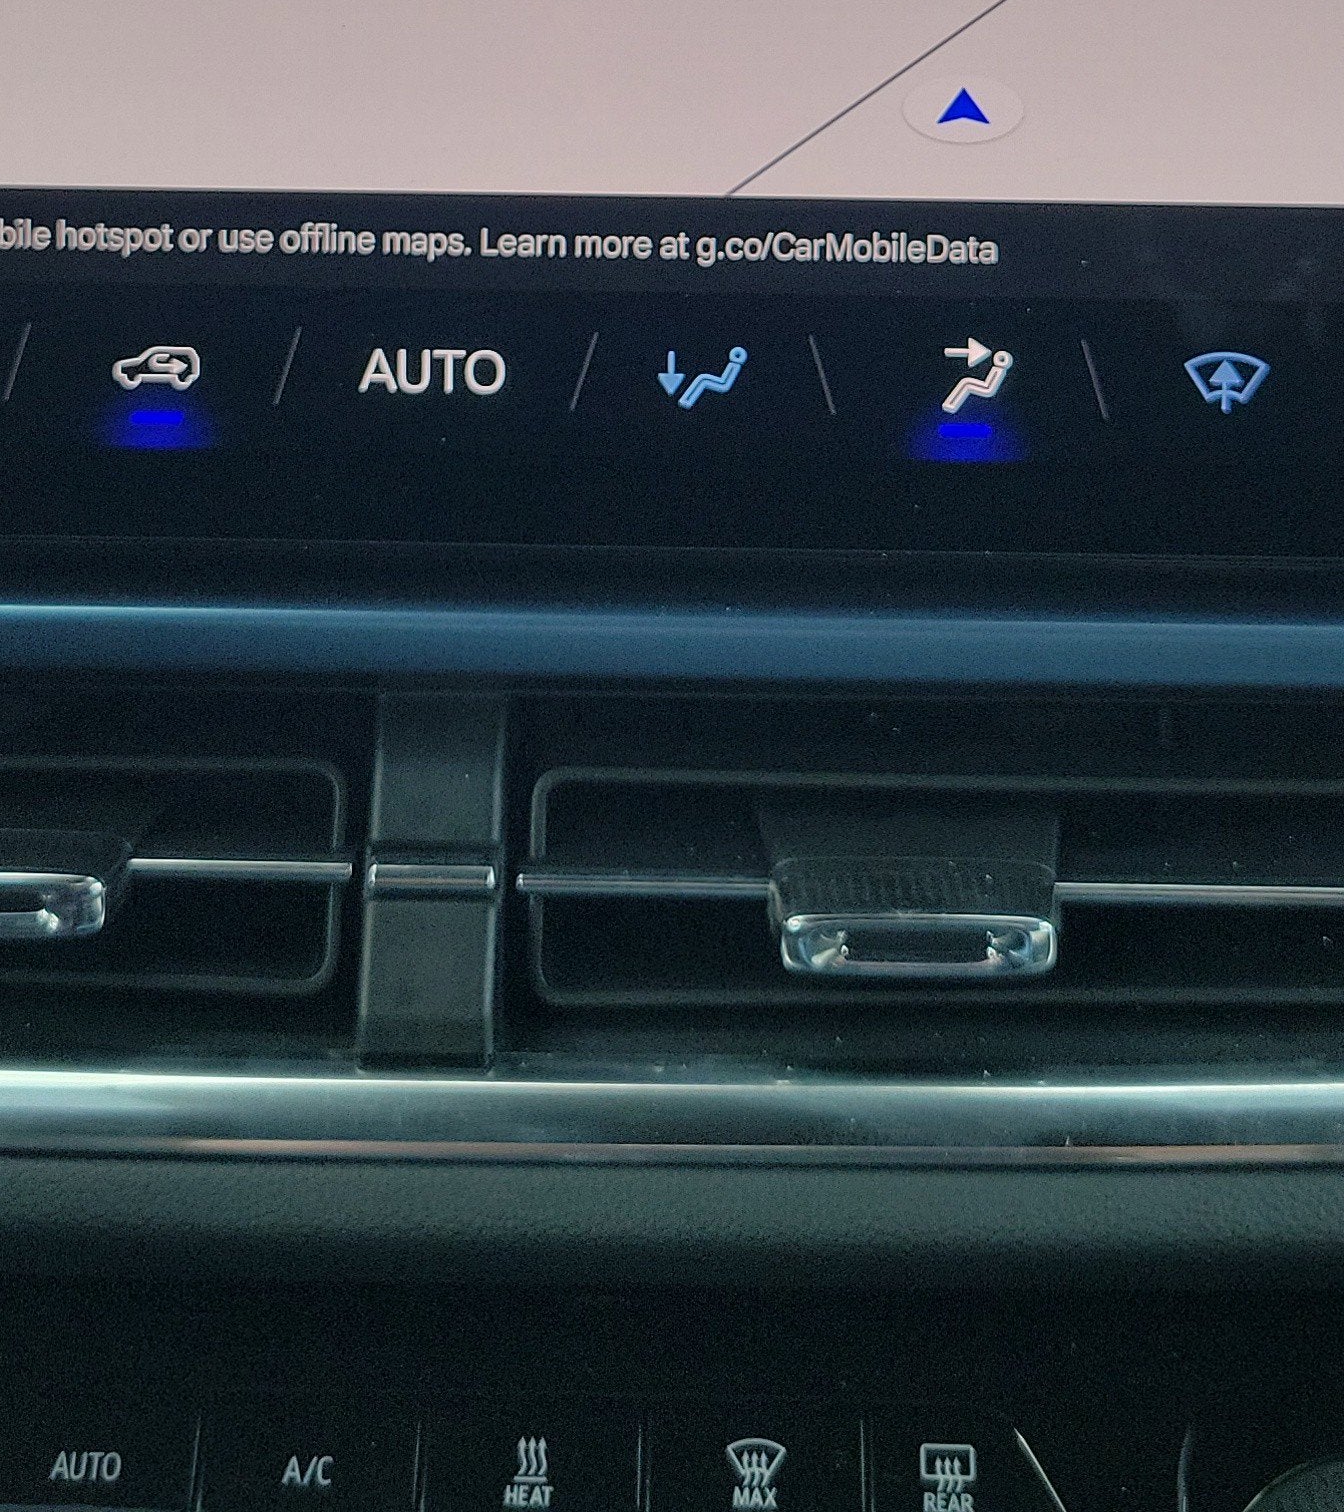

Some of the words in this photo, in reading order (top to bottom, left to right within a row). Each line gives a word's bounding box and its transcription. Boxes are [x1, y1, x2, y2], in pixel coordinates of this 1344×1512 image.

[55, 218, 175, 258] hotspot
[177, 228, 214, 253] or
[217, 229, 274, 254] use
[279, 222, 376, 255] offline
[382, 231, 473, 263] maps.
[479, 227, 567, 258] Learn
[573, 234, 654, 260] more
[659, 232, 690, 261] at
[695, 231, 1000, 267] g.co/CarMobileData
[357, 346, 507, 397] AUTO
[48, 1450, 122, 1483] AUTO
[280, 1454, 334, 1487] A/C
[503, 1484, 555, 1509] HEAT
[731, 1486, 778, 1510] MAX
[922, 1491, 975, 1512] REAR
